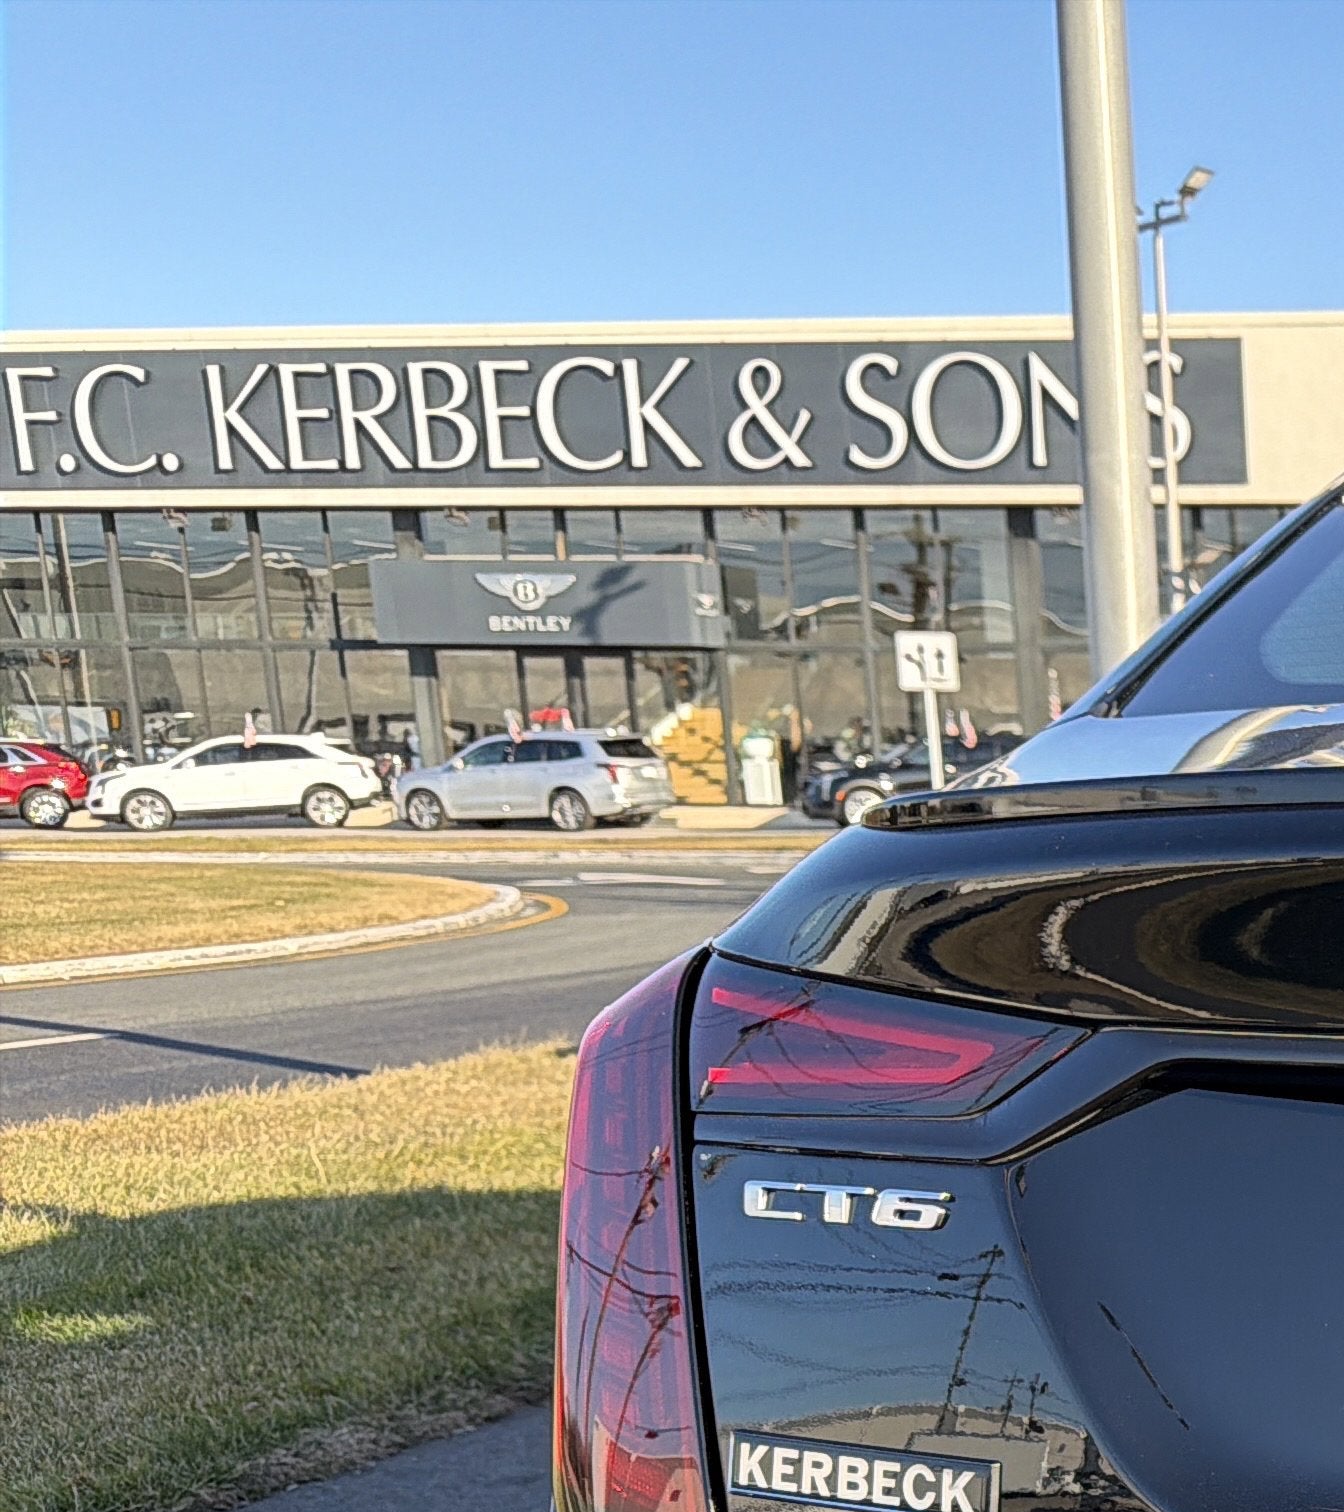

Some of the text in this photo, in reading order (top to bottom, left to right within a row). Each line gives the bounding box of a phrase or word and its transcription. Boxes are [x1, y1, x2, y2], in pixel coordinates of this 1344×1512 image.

[4, 361, 180, 474] F.C.
[204, 355, 703, 472] KERBECK
[727, 357, 813, 470] &
[488, 615, 572, 632] BENTLEY
[743, 1180, 956, 1230] CT6
